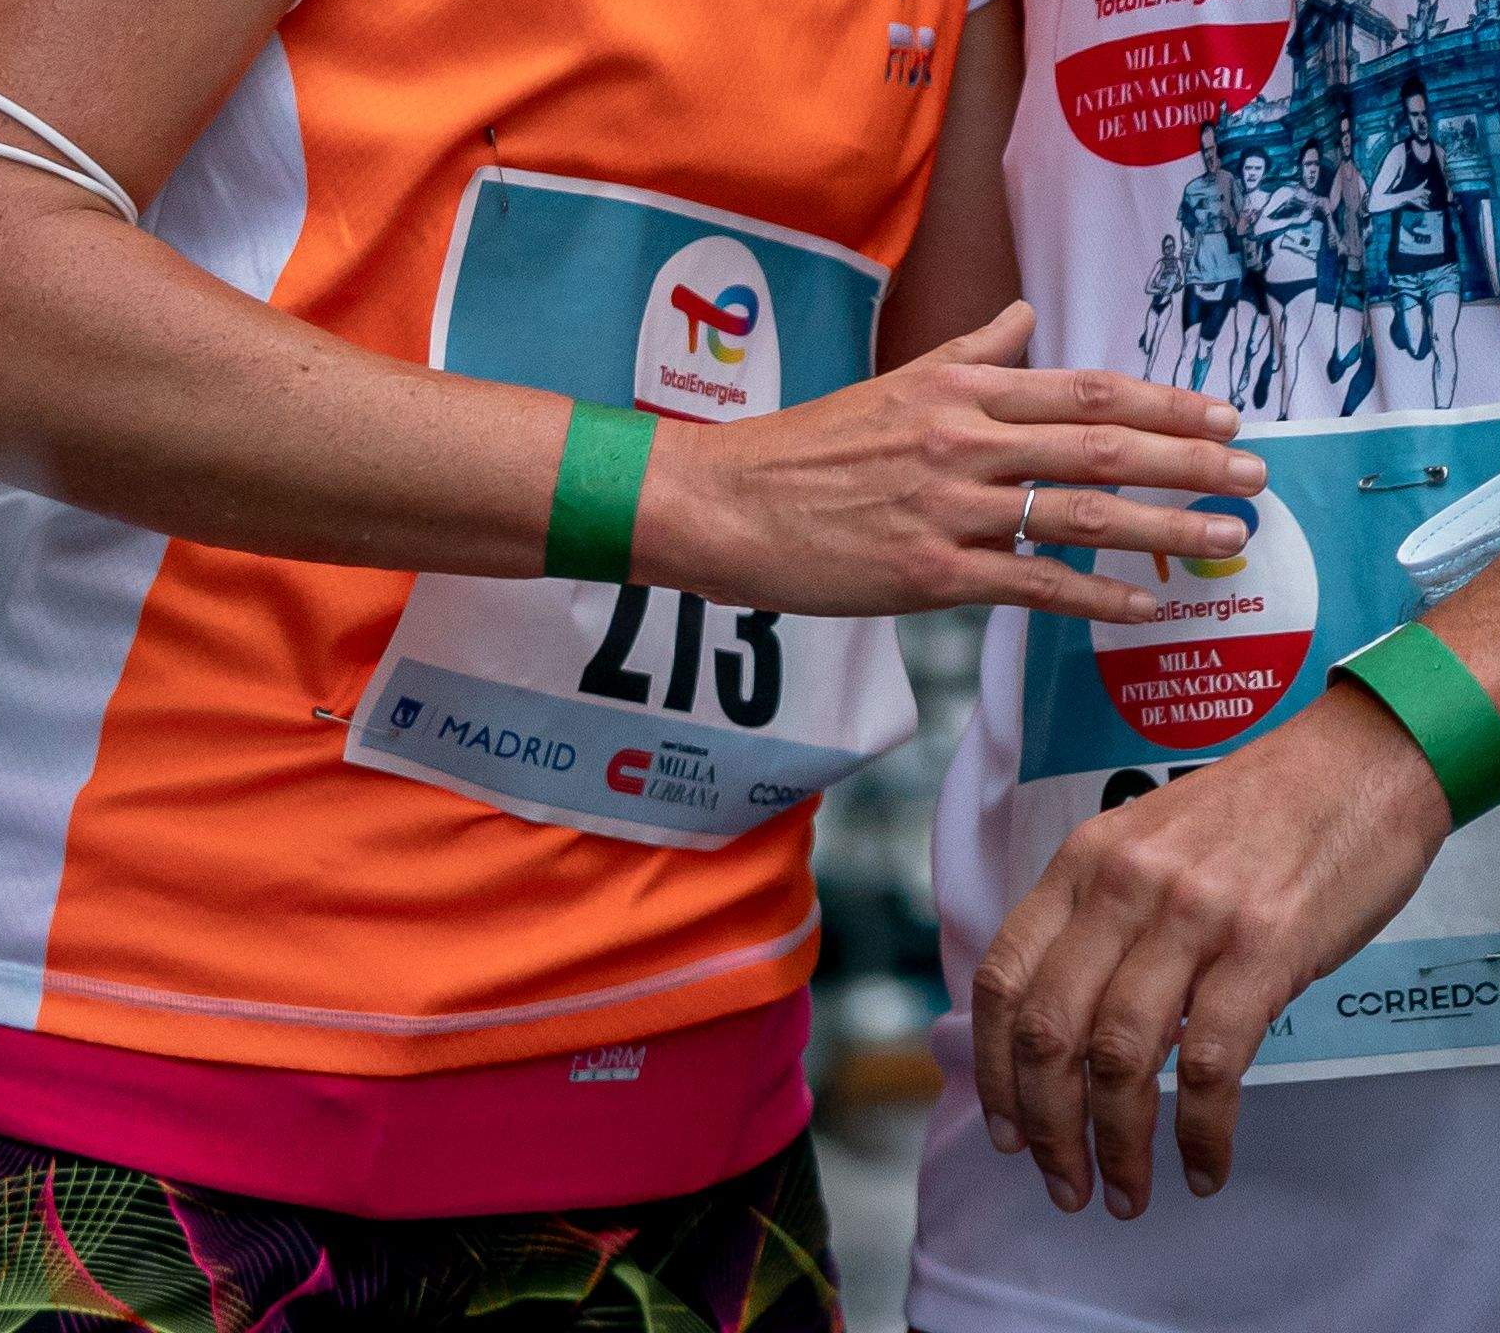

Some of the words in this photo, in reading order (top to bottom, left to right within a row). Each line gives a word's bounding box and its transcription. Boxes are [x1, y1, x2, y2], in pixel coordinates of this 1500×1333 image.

[1125, 40, 1192, 70] MILLA
[1098, 115, 1127, 141] DE
[1133, 100, 1216, 133] MADRID
[660, 365, 747, 406] TotalEnergies
[1154, 593, 1265, 622] alEnergies
[1159, 648, 1223, 672] MILLA
[1141, 706, 1167, 726] DE
[1170, 697, 1254, 725] MADRID
[439, 714, 578, 772] MADRID
[654, 753, 717, 783] MILLA
